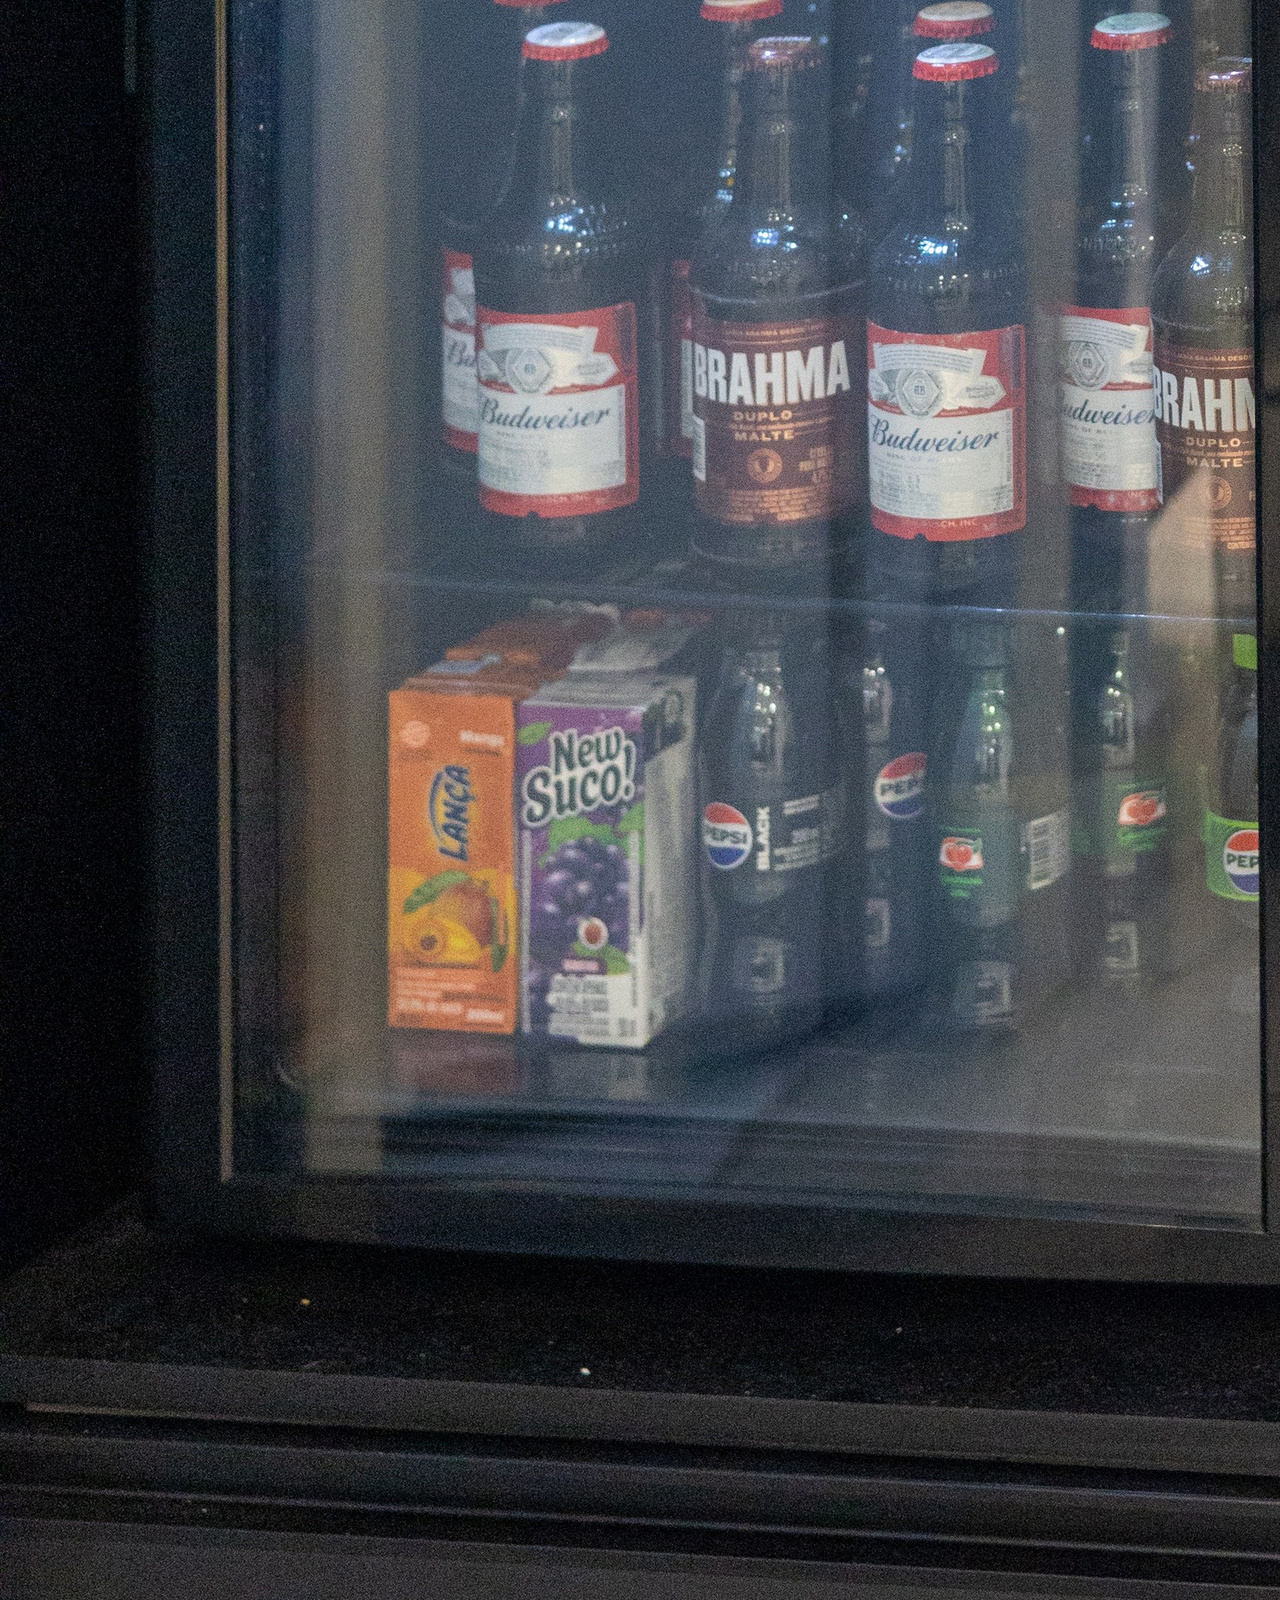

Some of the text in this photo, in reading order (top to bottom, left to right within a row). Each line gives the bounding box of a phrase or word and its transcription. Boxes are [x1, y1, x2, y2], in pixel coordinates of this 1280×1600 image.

[694, 339, 851, 407] BRAHMA
[481, 398, 611, 430] Budweiser
[733, 409, 794, 422] DUPLO
[1063, 400, 1156, 426] udweiser
[734, 430, 795, 442] MALTE
[871, 414, 1000, 454] Budweiser
[1186, 436, 1242, 448] DUPLO
[1187, 458, 1243, 469] MALTE
[551, 726, 626, 775] New
[524, 740, 637, 827] Suco!
[437, 764, 471, 862] LANÇA
[756, 806, 771, 871] BLACK
